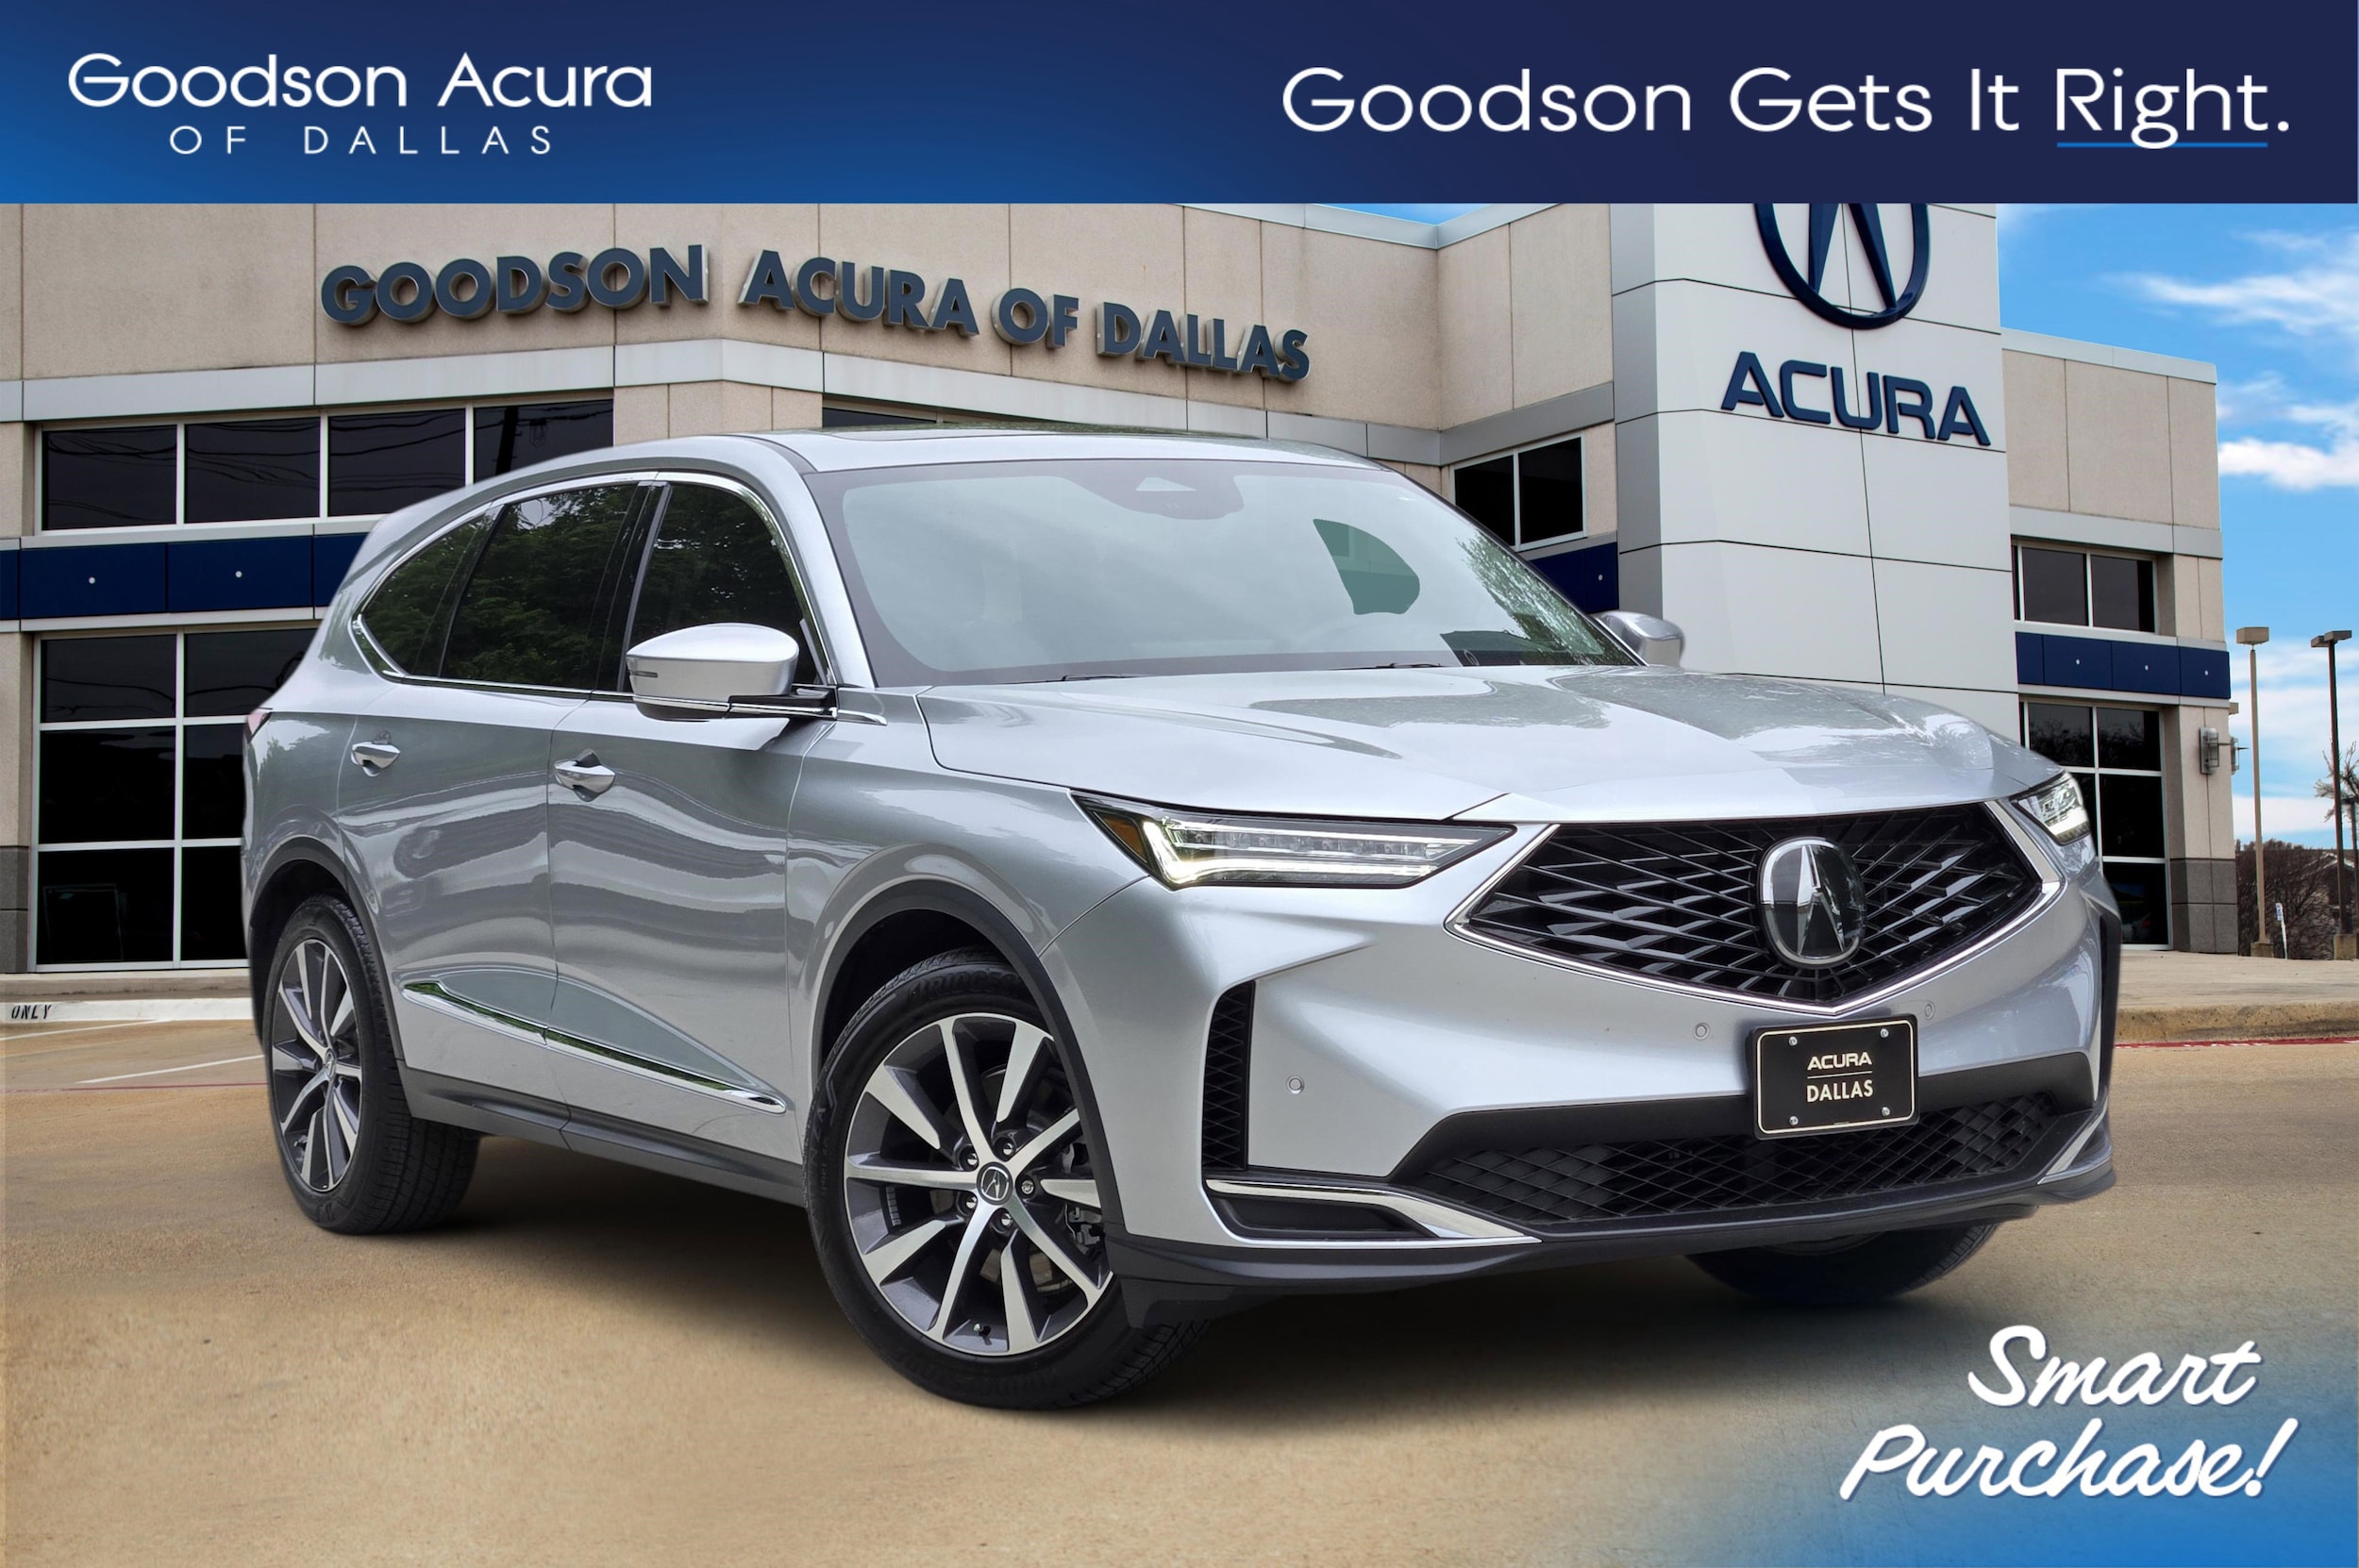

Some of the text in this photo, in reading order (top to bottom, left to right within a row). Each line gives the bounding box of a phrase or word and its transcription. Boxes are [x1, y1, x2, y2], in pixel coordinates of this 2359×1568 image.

[321, 244, 1311, 381] GOODSON ACURA OF DALLAS
[1721, 351, 1991, 446] ACURA
[11, 1004, 52, 1020] ONLY
[1807, 1052, 1873, 1071] ACURA
[1806, 1079, 1874, 1103] DALLAS
